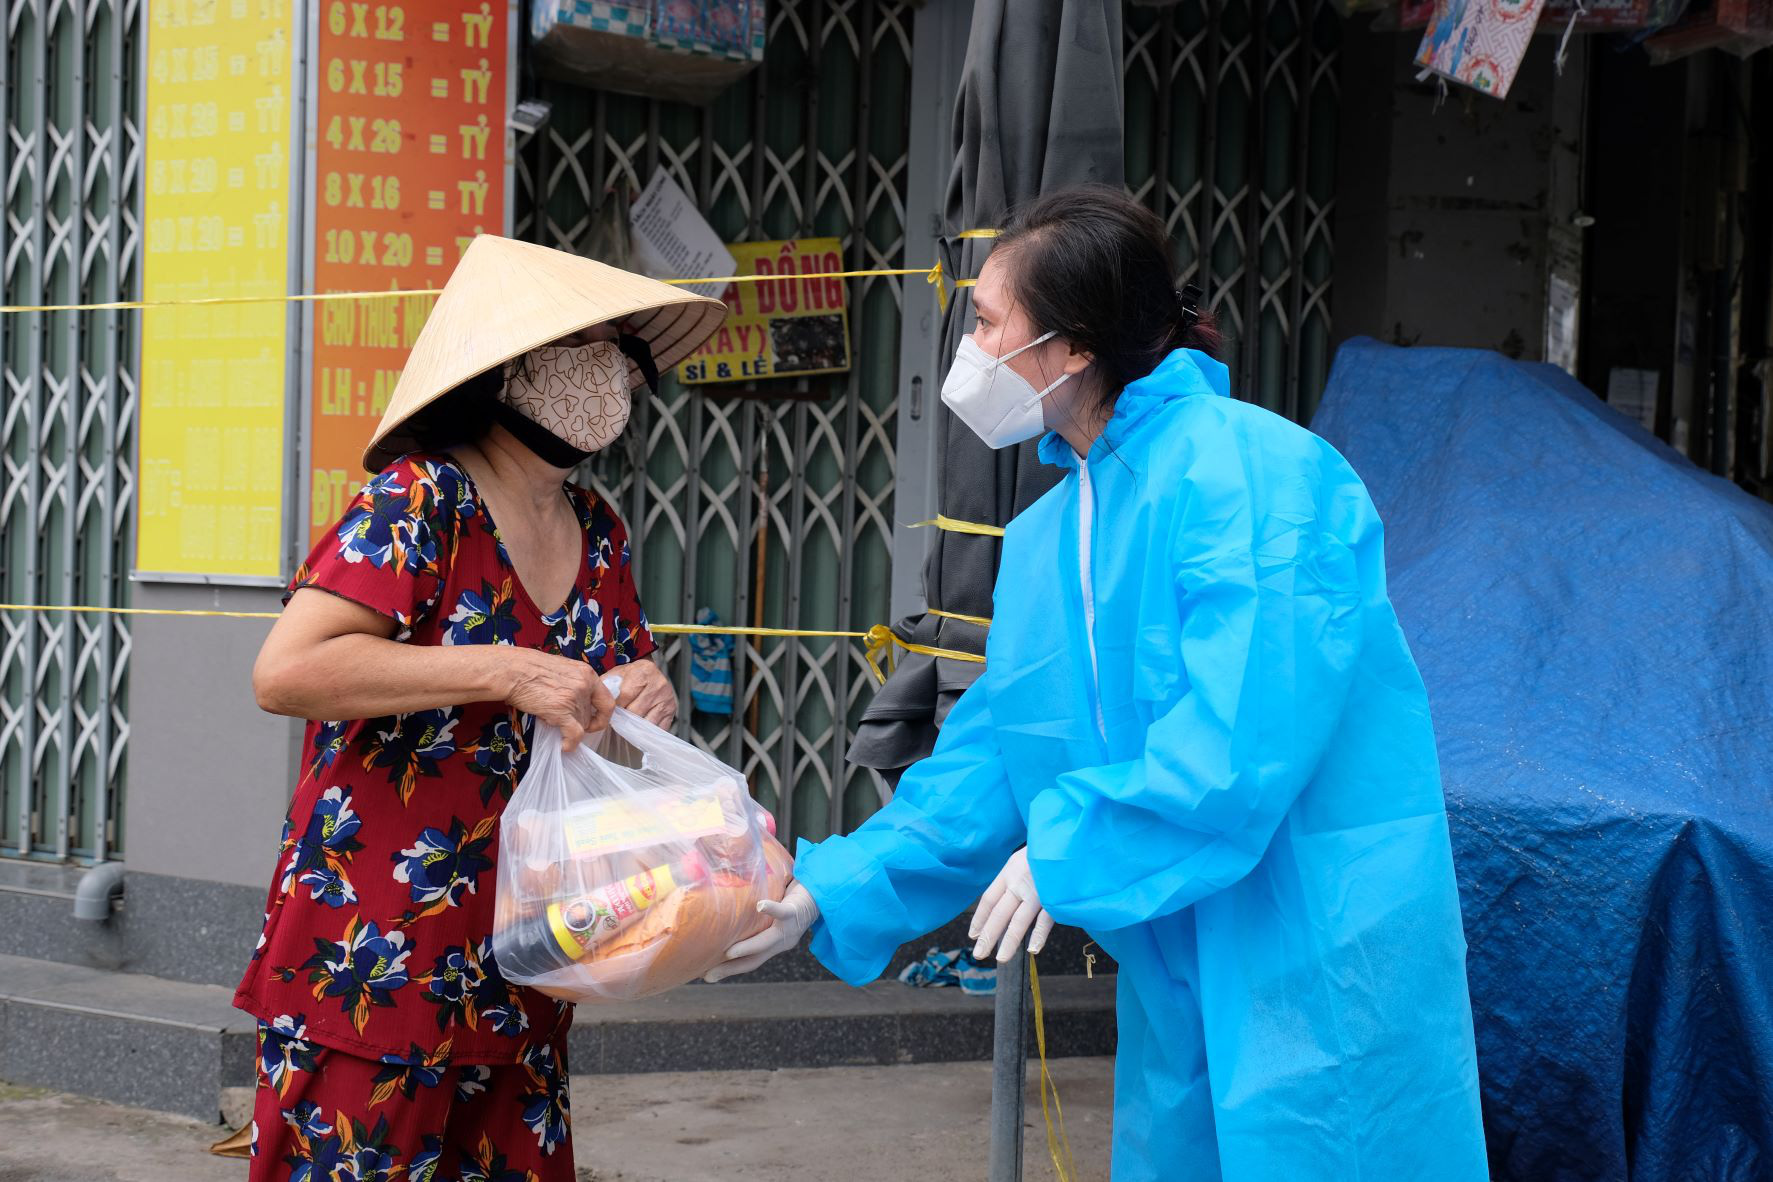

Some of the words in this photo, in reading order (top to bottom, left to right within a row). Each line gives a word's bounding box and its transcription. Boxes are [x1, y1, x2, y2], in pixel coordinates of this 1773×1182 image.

[328, 1, 346, 36] 6
[350, 3, 368, 38] X
[374, 5, 404, 41] 12
[432, 22, 449, 42] =
[461, 2, 493, 48] TỶ
[327, 57, 345, 93] 6
[349, 60, 367, 95] X
[374, 62, 403, 97] 15
[431, 77, 448, 98] =
[460, 57, 492, 104] TỶ
[326, 115, 343, 149] 4
[347, 116, 366, 151] X
[370, 118, 401, 154] 26
[430, 134, 447, 154] =
[459, 114, 491, 160] TỶ
[325, 171, 342, 206] 8
[346, 172, 365, 208] X
[371, 175, 400, 210] 16
[428, 190, 445, 210] =
[457, 169, 488, 215] TỶ
[325, 228, 355, 264] 10
[359, 230, 378, 265] X
[381, 232, 413, 268] 20
[426, 246, 443, 266] =
[755, 239, 844, 315] ĐỒNG
[322, 368, 352, 416] LH
[717, 362, 731, 378] &
